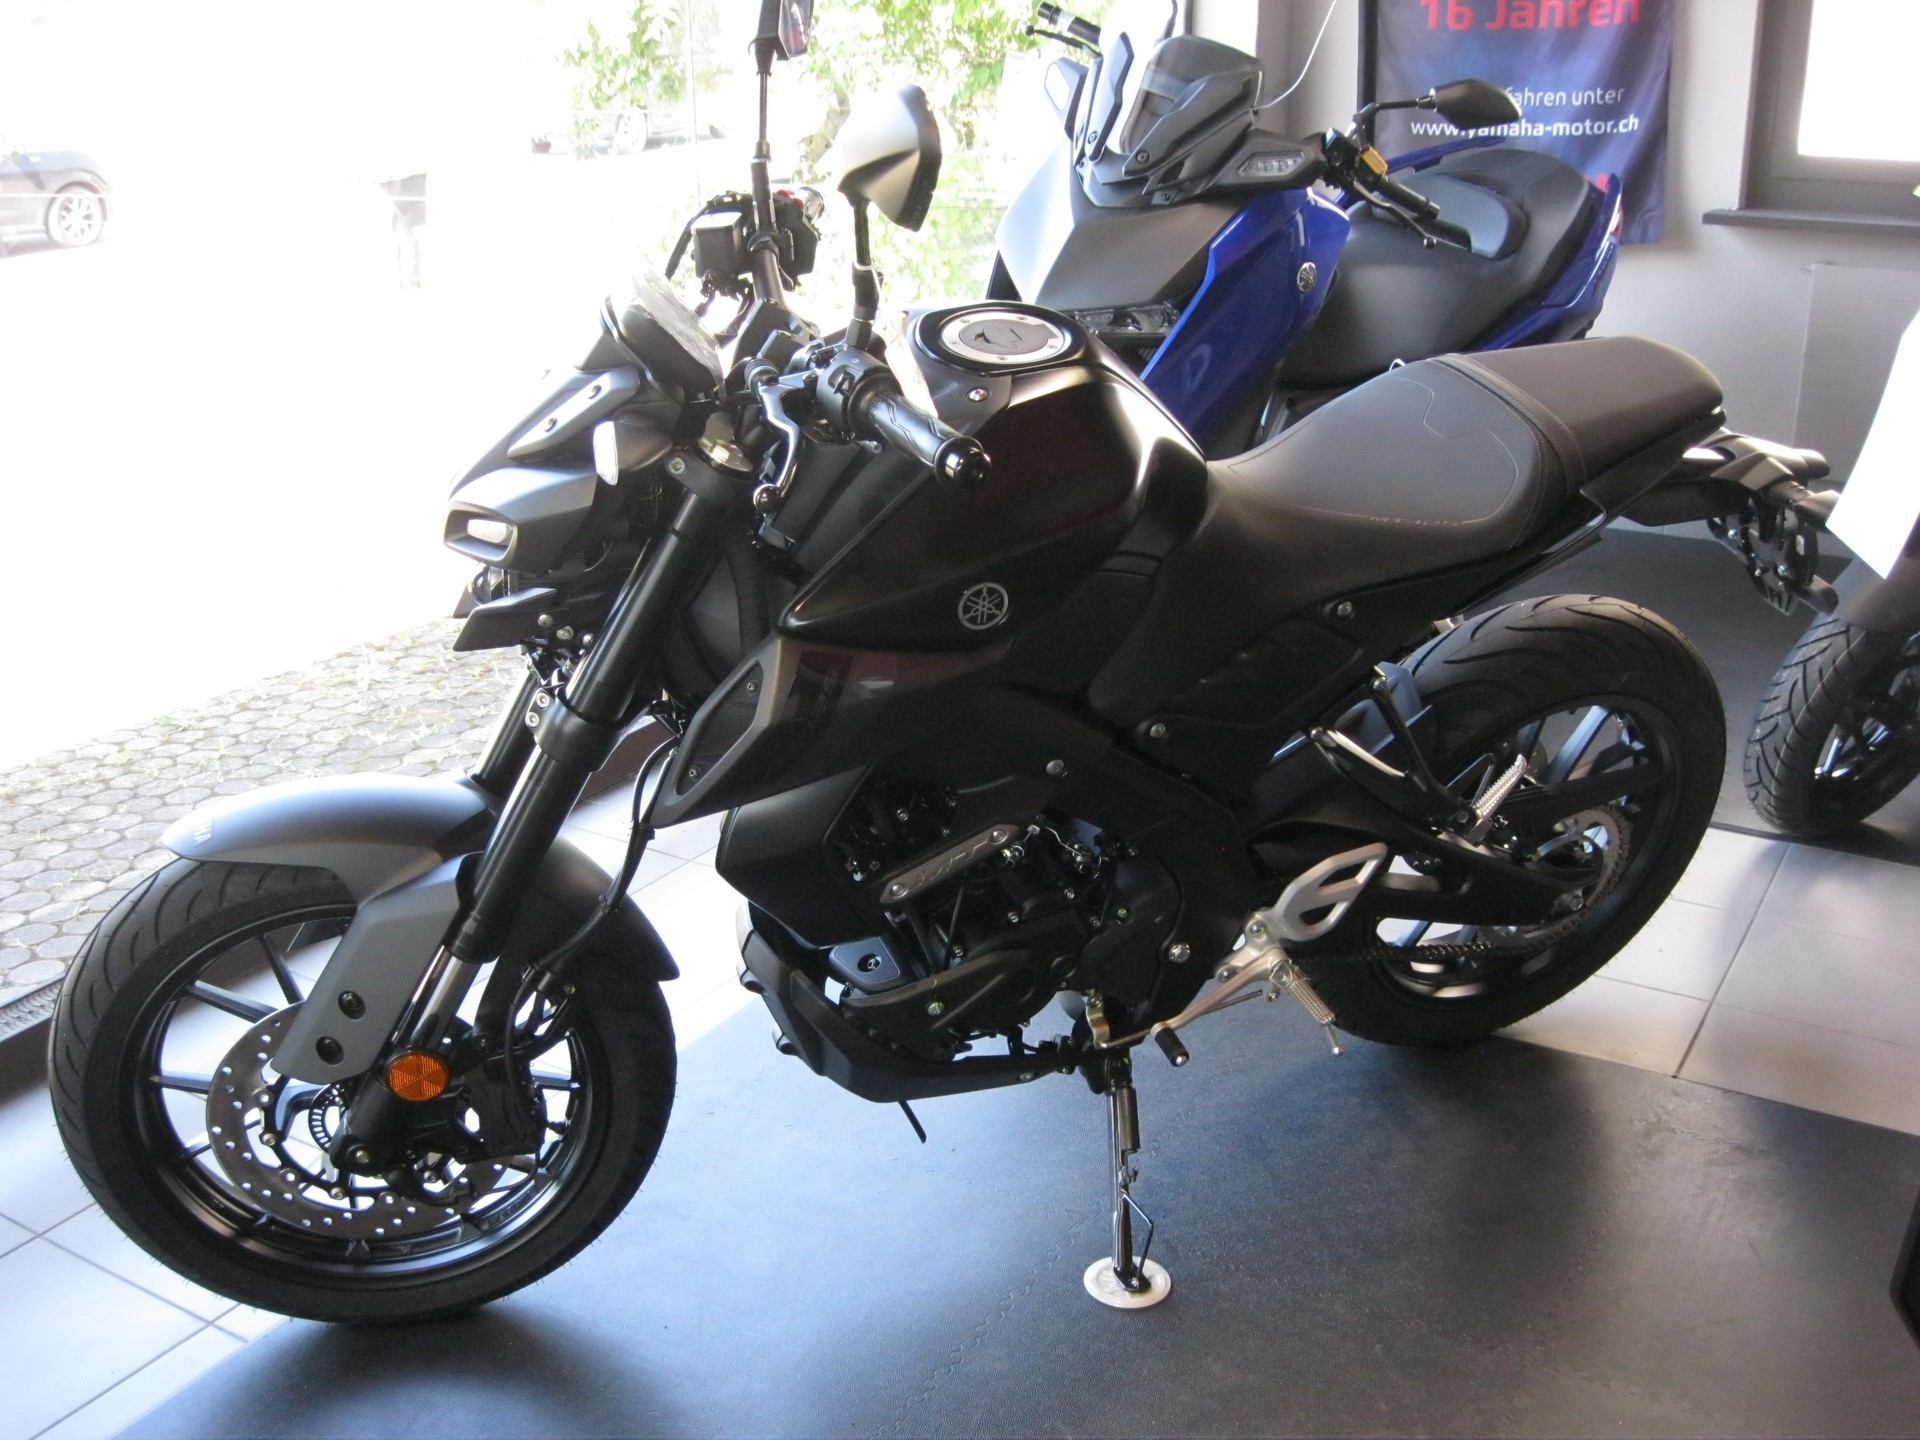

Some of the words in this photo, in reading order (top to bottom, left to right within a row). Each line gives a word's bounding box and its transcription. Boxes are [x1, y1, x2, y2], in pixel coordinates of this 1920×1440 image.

[1421, 0, 1472, 31] 16
[1486, 0, 1640, 30] Jahren
[1572, 87, 1625, 106] unter
